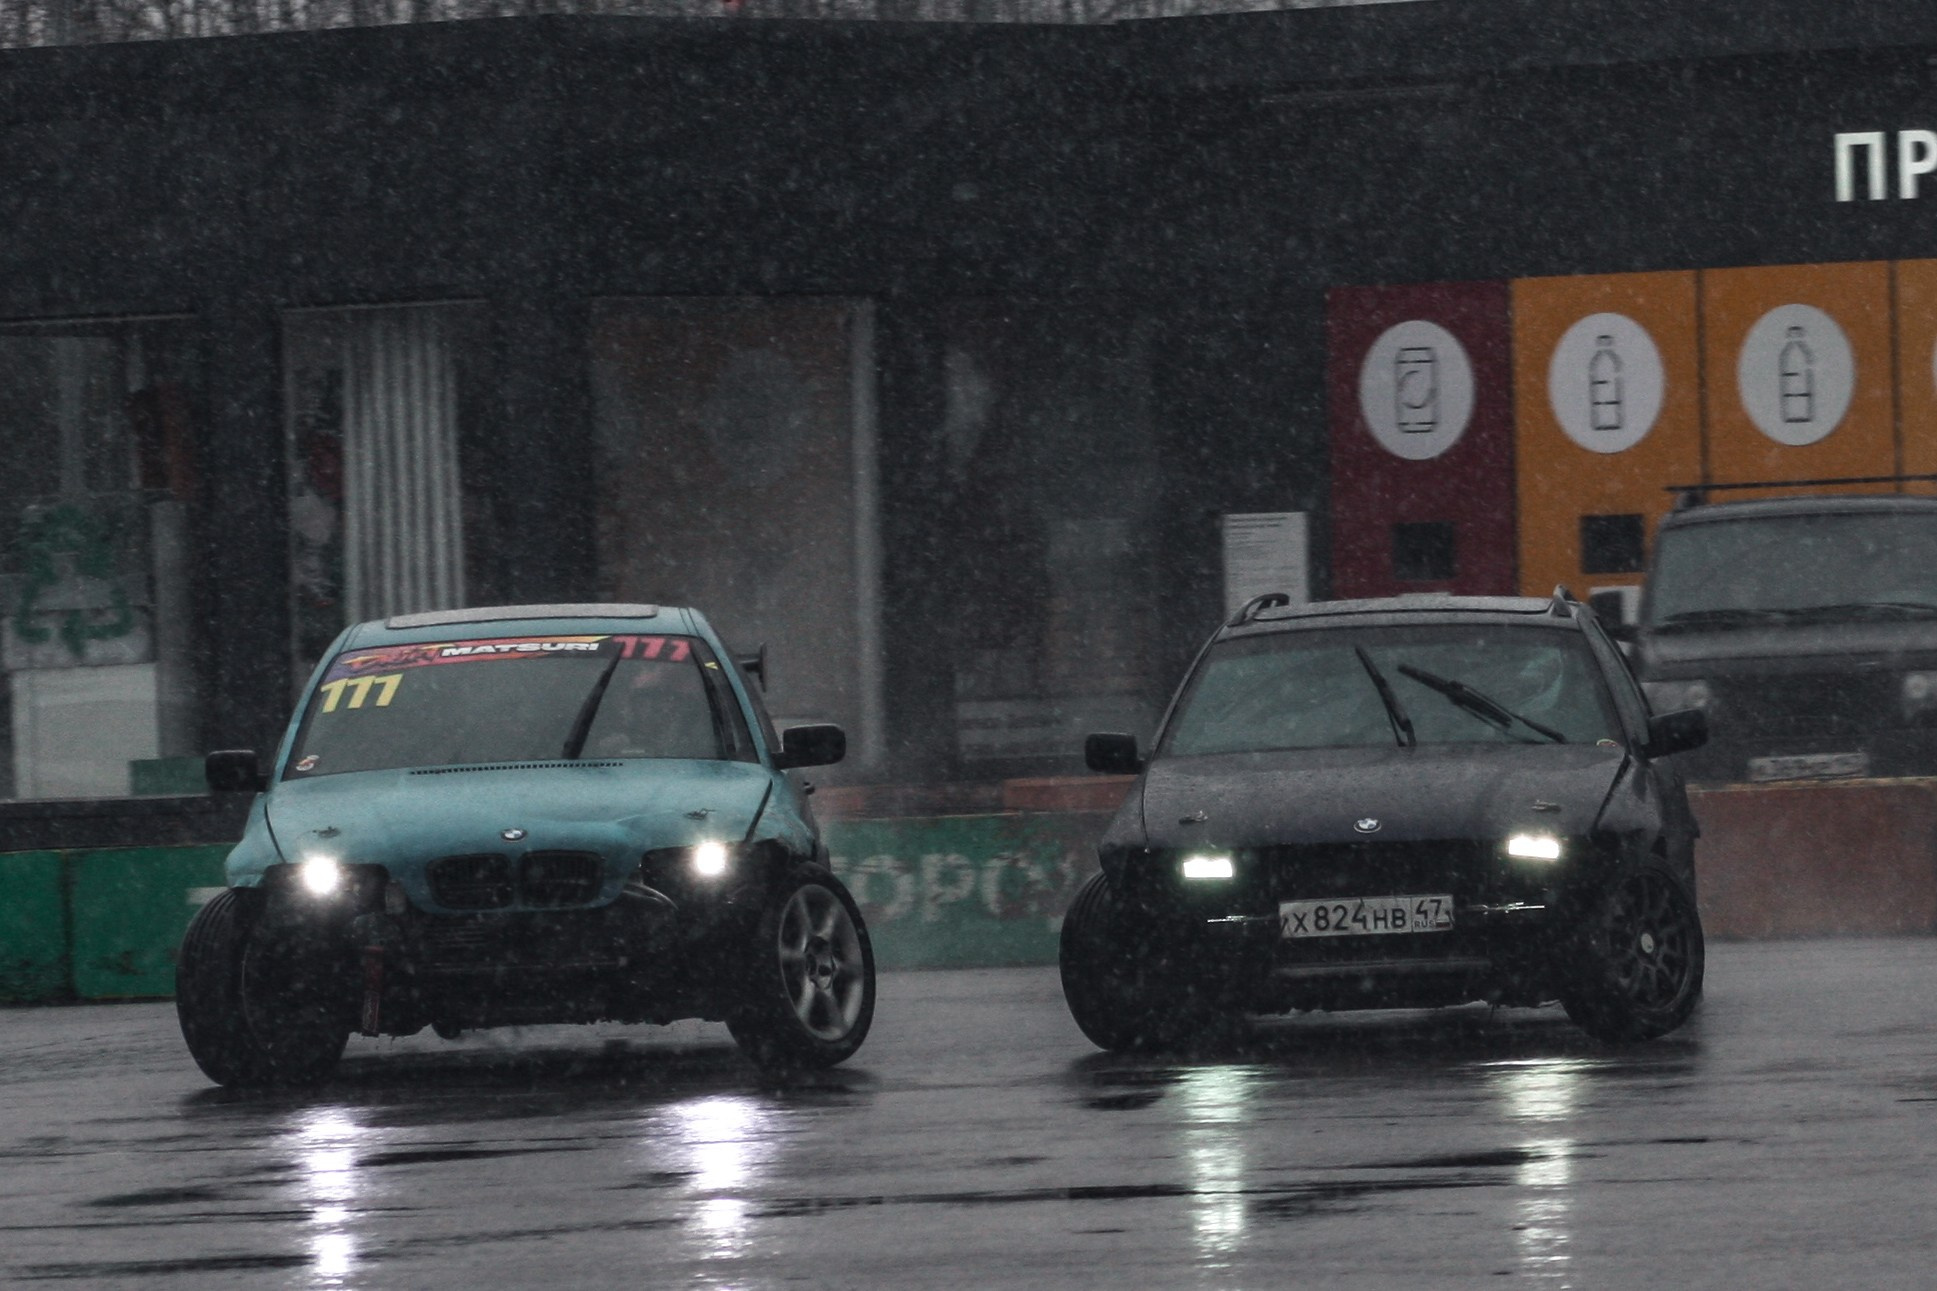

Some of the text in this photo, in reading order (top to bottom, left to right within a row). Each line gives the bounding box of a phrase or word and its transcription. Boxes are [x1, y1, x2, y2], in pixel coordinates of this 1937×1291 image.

[1835, 130, 1937, 202] ПР
[441, 641, 600, 658] MATSURI
[1415, 898, 1441, 920] 47
[1414, 919, 1436, 929] RUS
